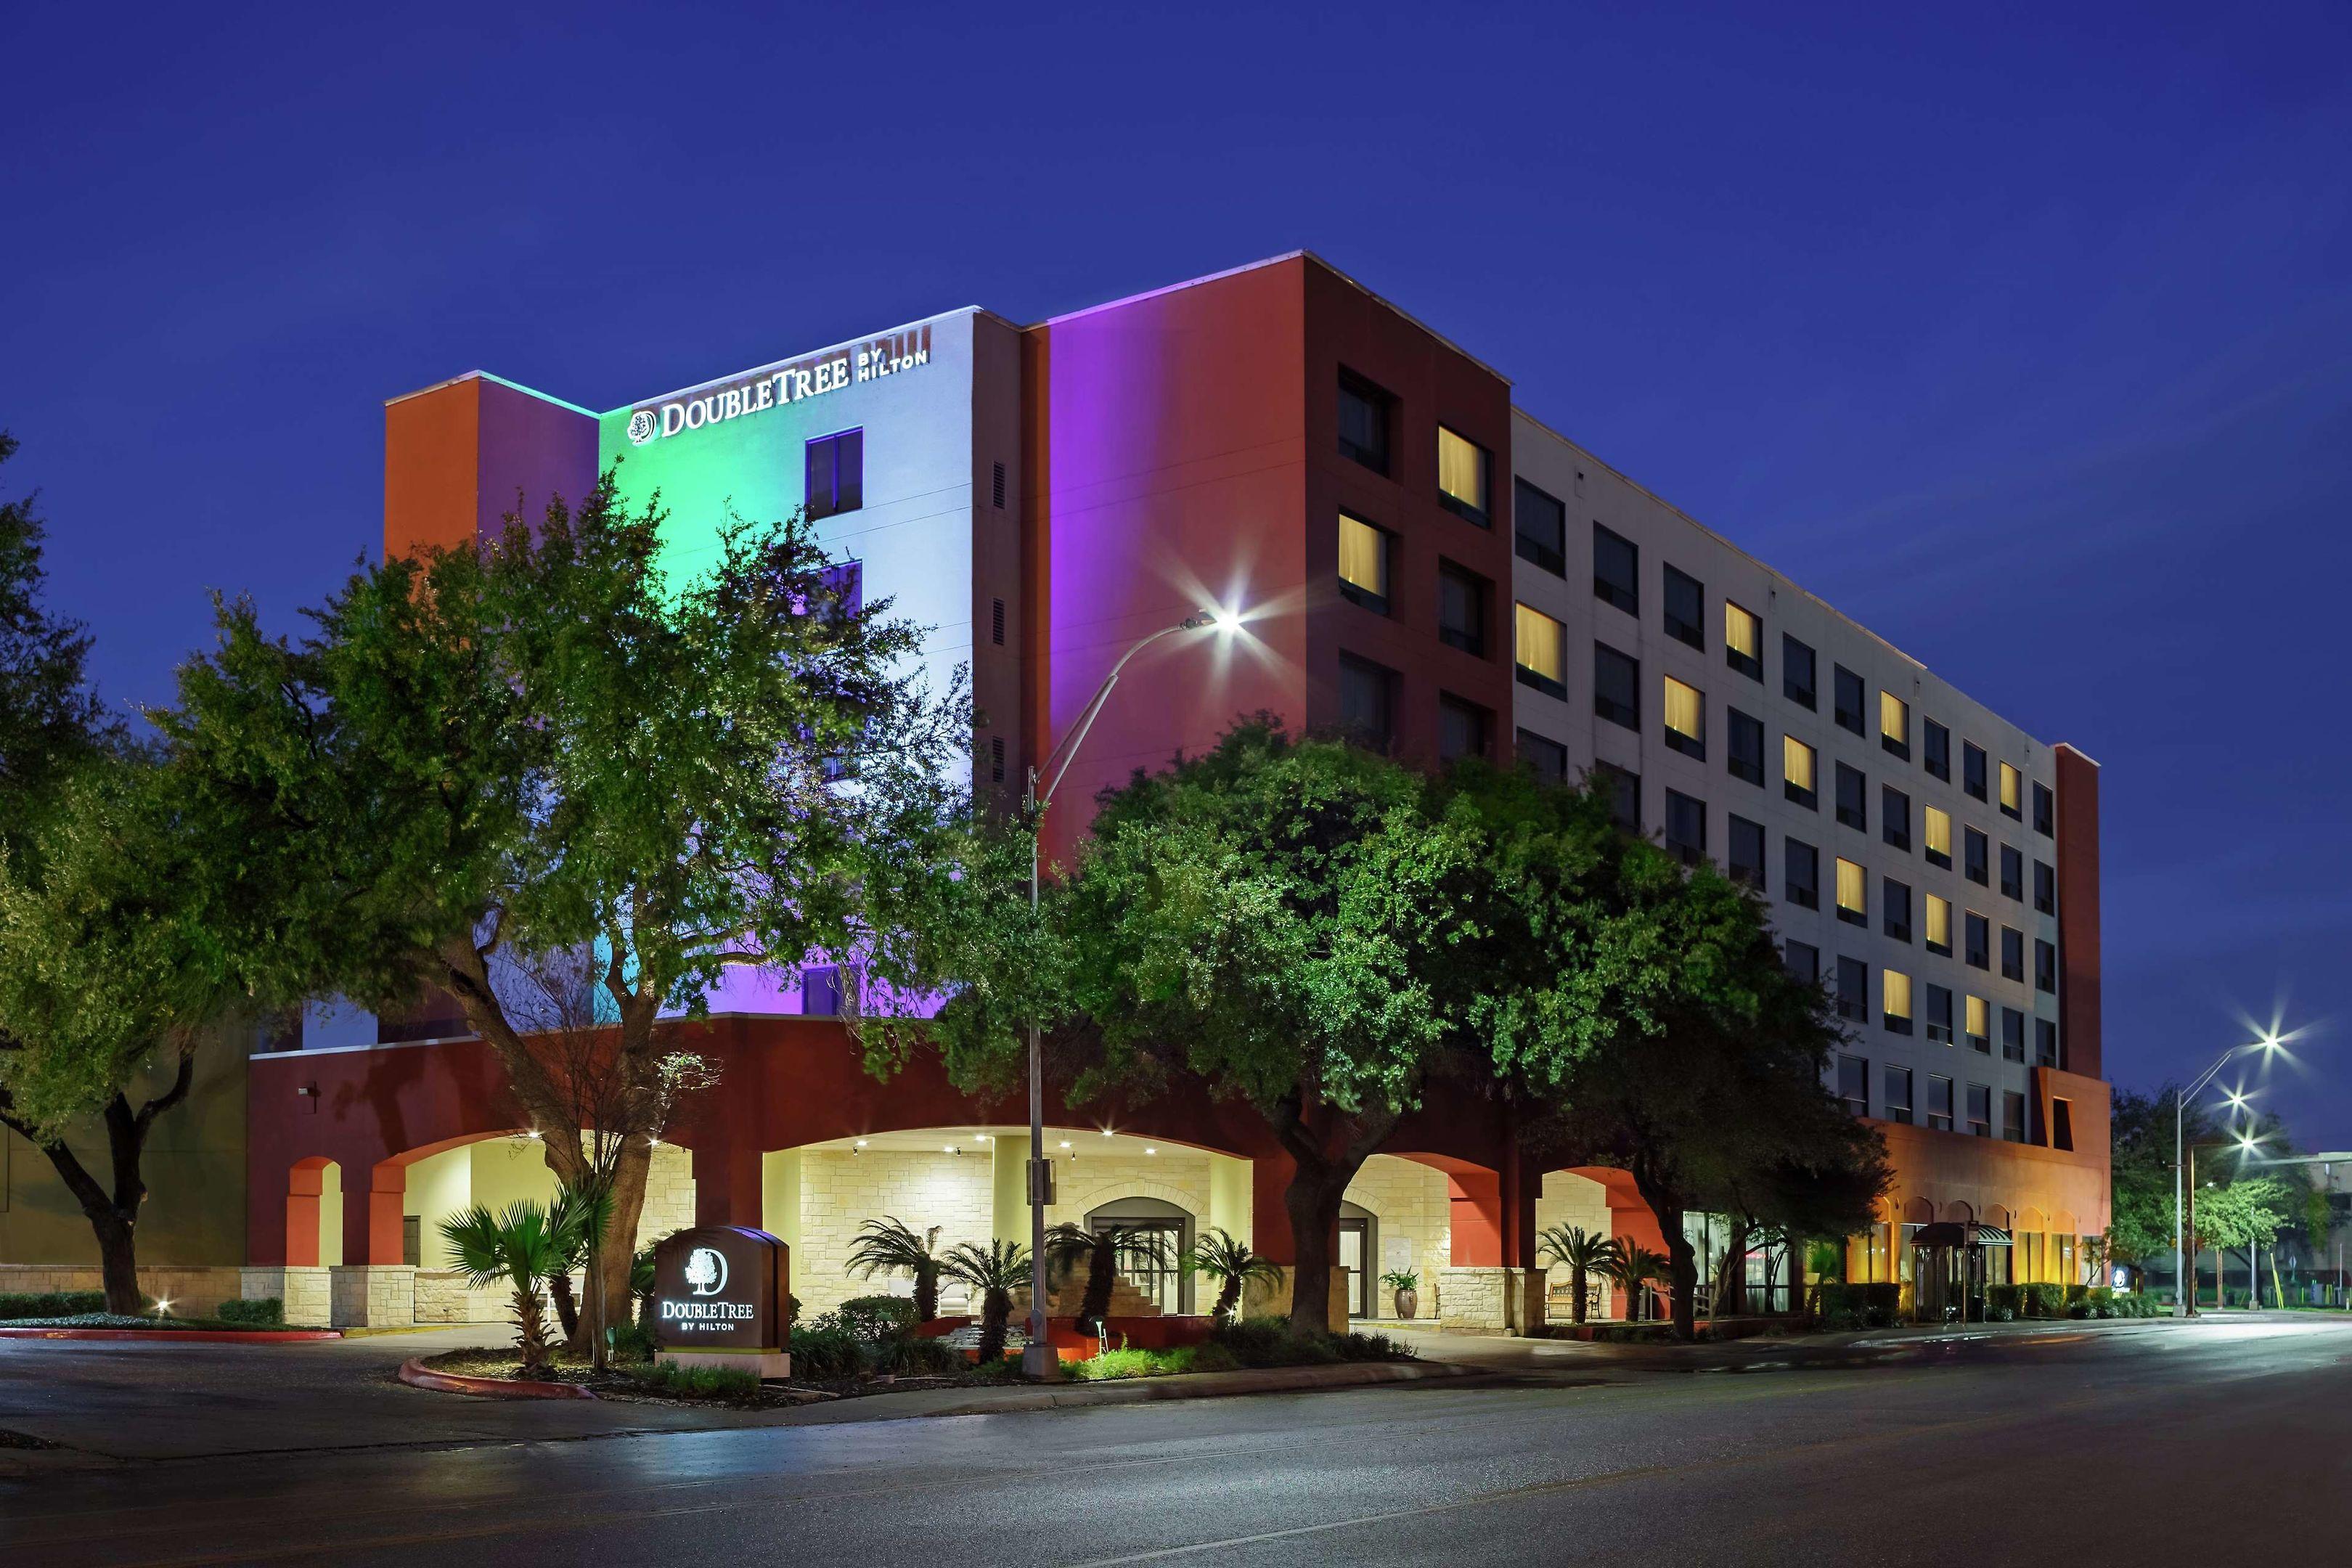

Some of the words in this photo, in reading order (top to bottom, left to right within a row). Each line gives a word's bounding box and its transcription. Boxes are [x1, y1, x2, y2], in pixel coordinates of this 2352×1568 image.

[858, 348, 883, 367] BY
[858, 350, 927, 382] HILTON
[662, 358, 849, 438] DOUBLETREE
[662, 1302, 754, 1319] DOUBLETREE
